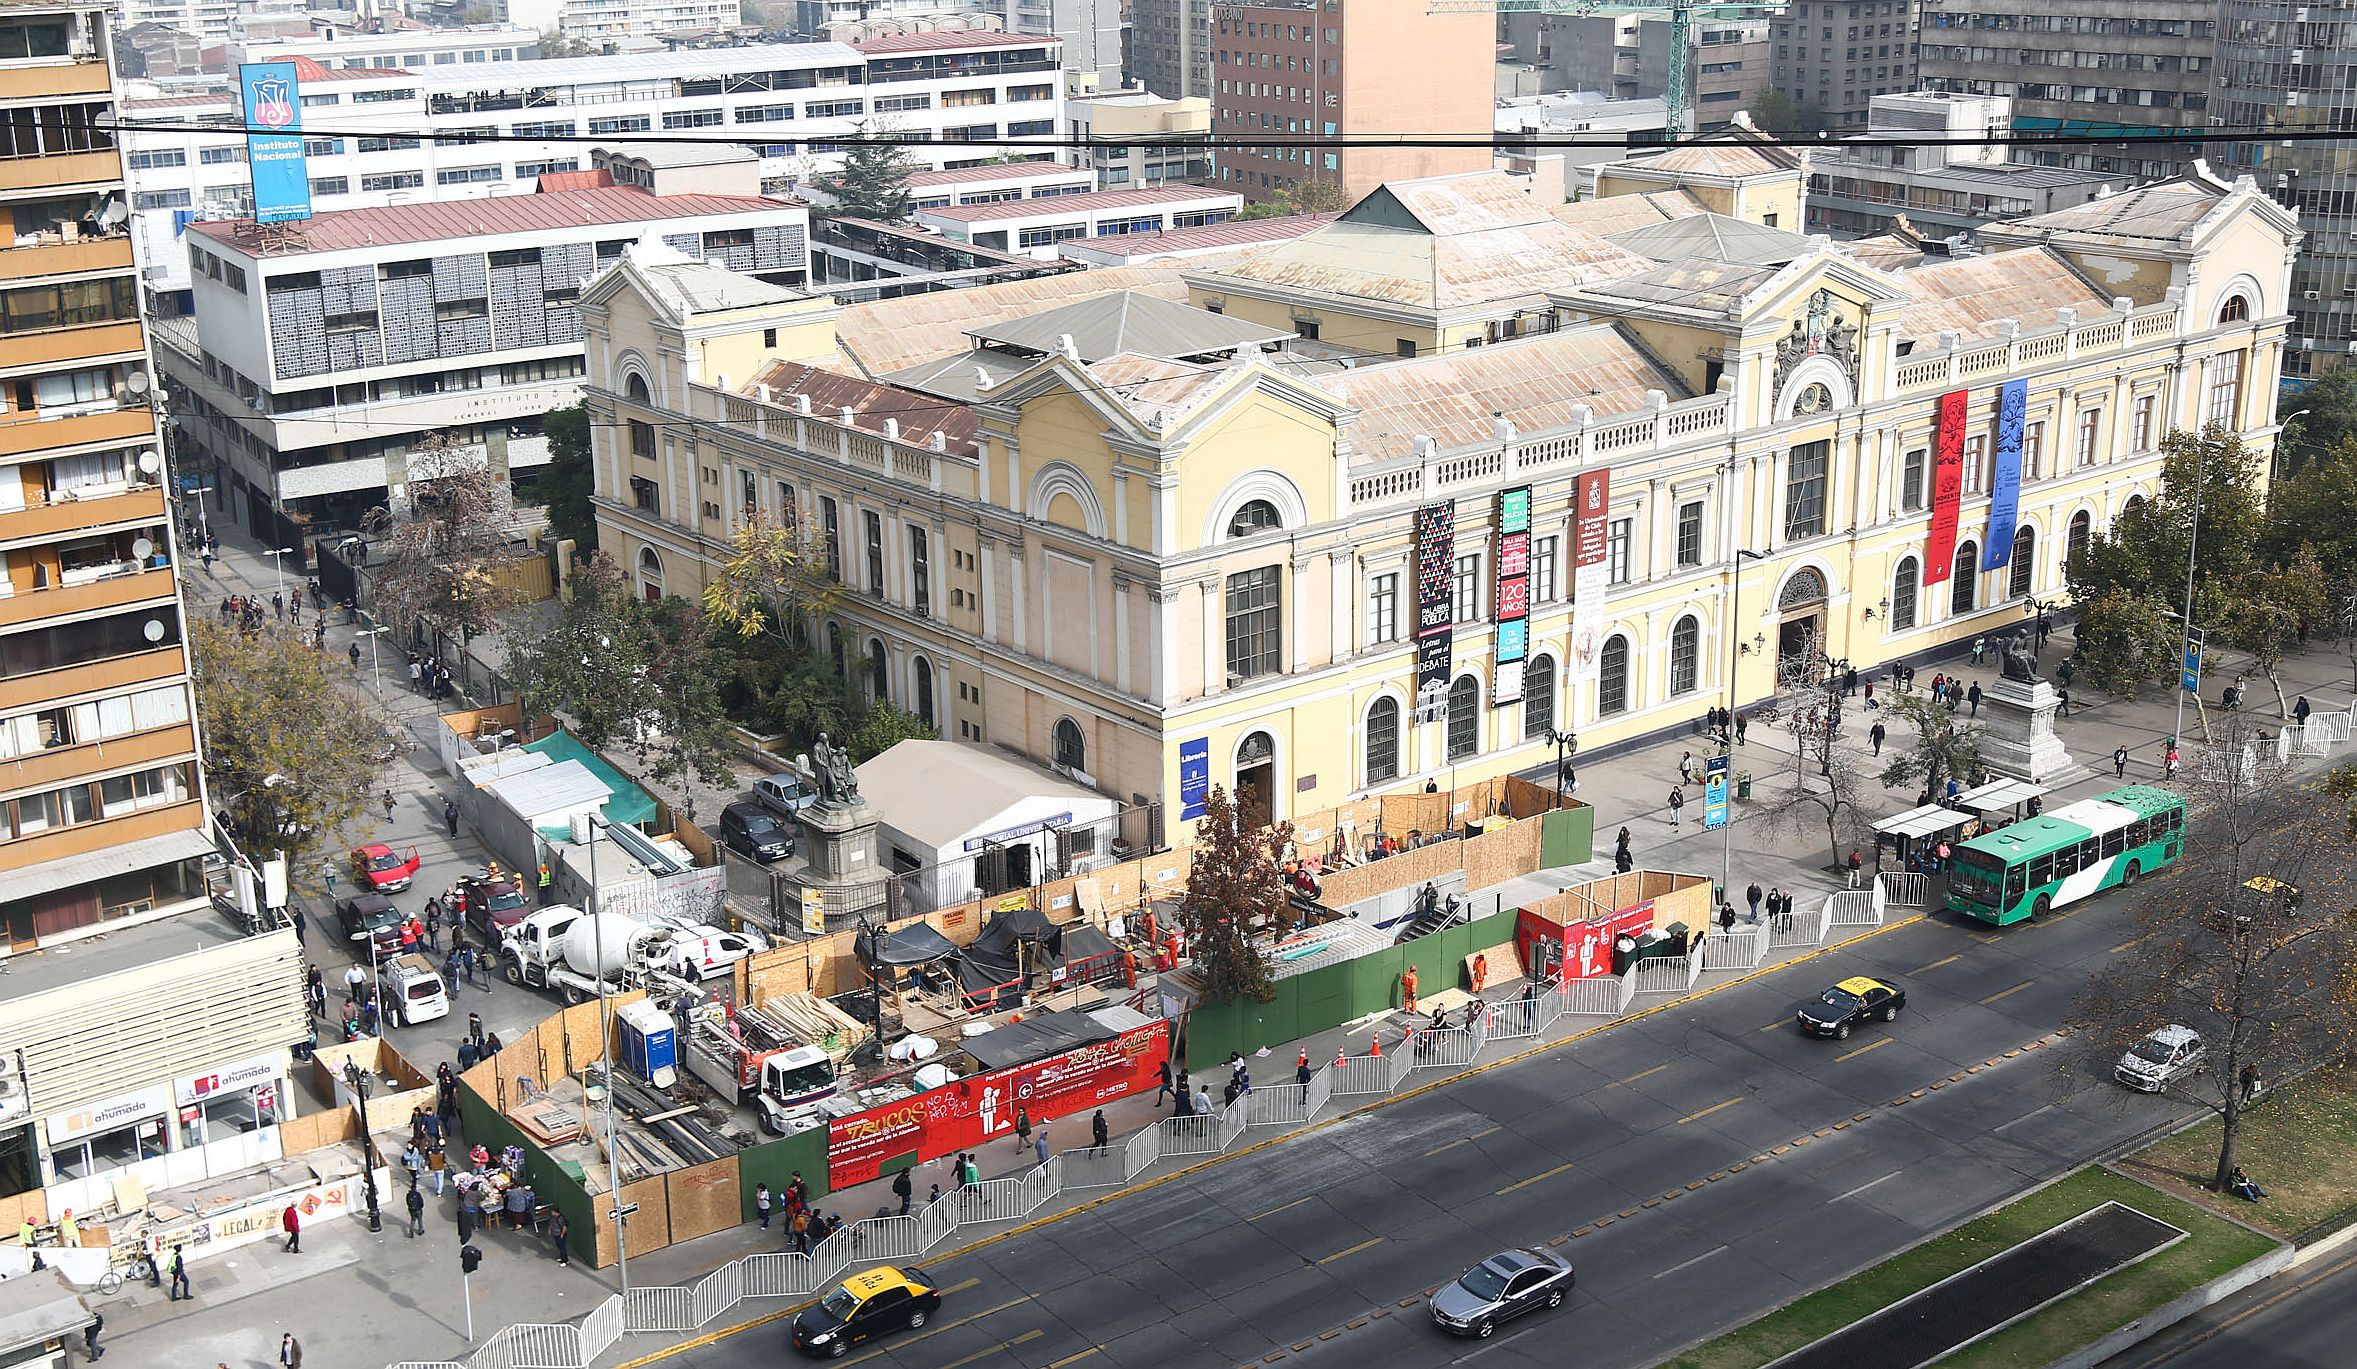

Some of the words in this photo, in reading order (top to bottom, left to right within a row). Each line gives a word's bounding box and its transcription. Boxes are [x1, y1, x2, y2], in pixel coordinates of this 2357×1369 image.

[254, 141, 299, 150] Instituto
[254, 151, 302, 161] Nacional
[467, 393, 539, 409] INSTITUTO
[1502, 583, 1526, 602] 120
[1422, 602, 1450, 617] PALABRA
[1501, 600, 1525, 613] AÑOS
[1442, 642, 1450, 653] el
[1420, 656, 1448, 674] DEBATE
[222, 1066, 270, 1085] ahumada
[986, 1074, 995, 1082] Por
[1106, 1082, 1128, 1093] METRO
[926, 1095, 942, 1108] NO
[94, 1102, 146, 1122] ahumada
[846, 1102, 928, 1140] TRUCOS
